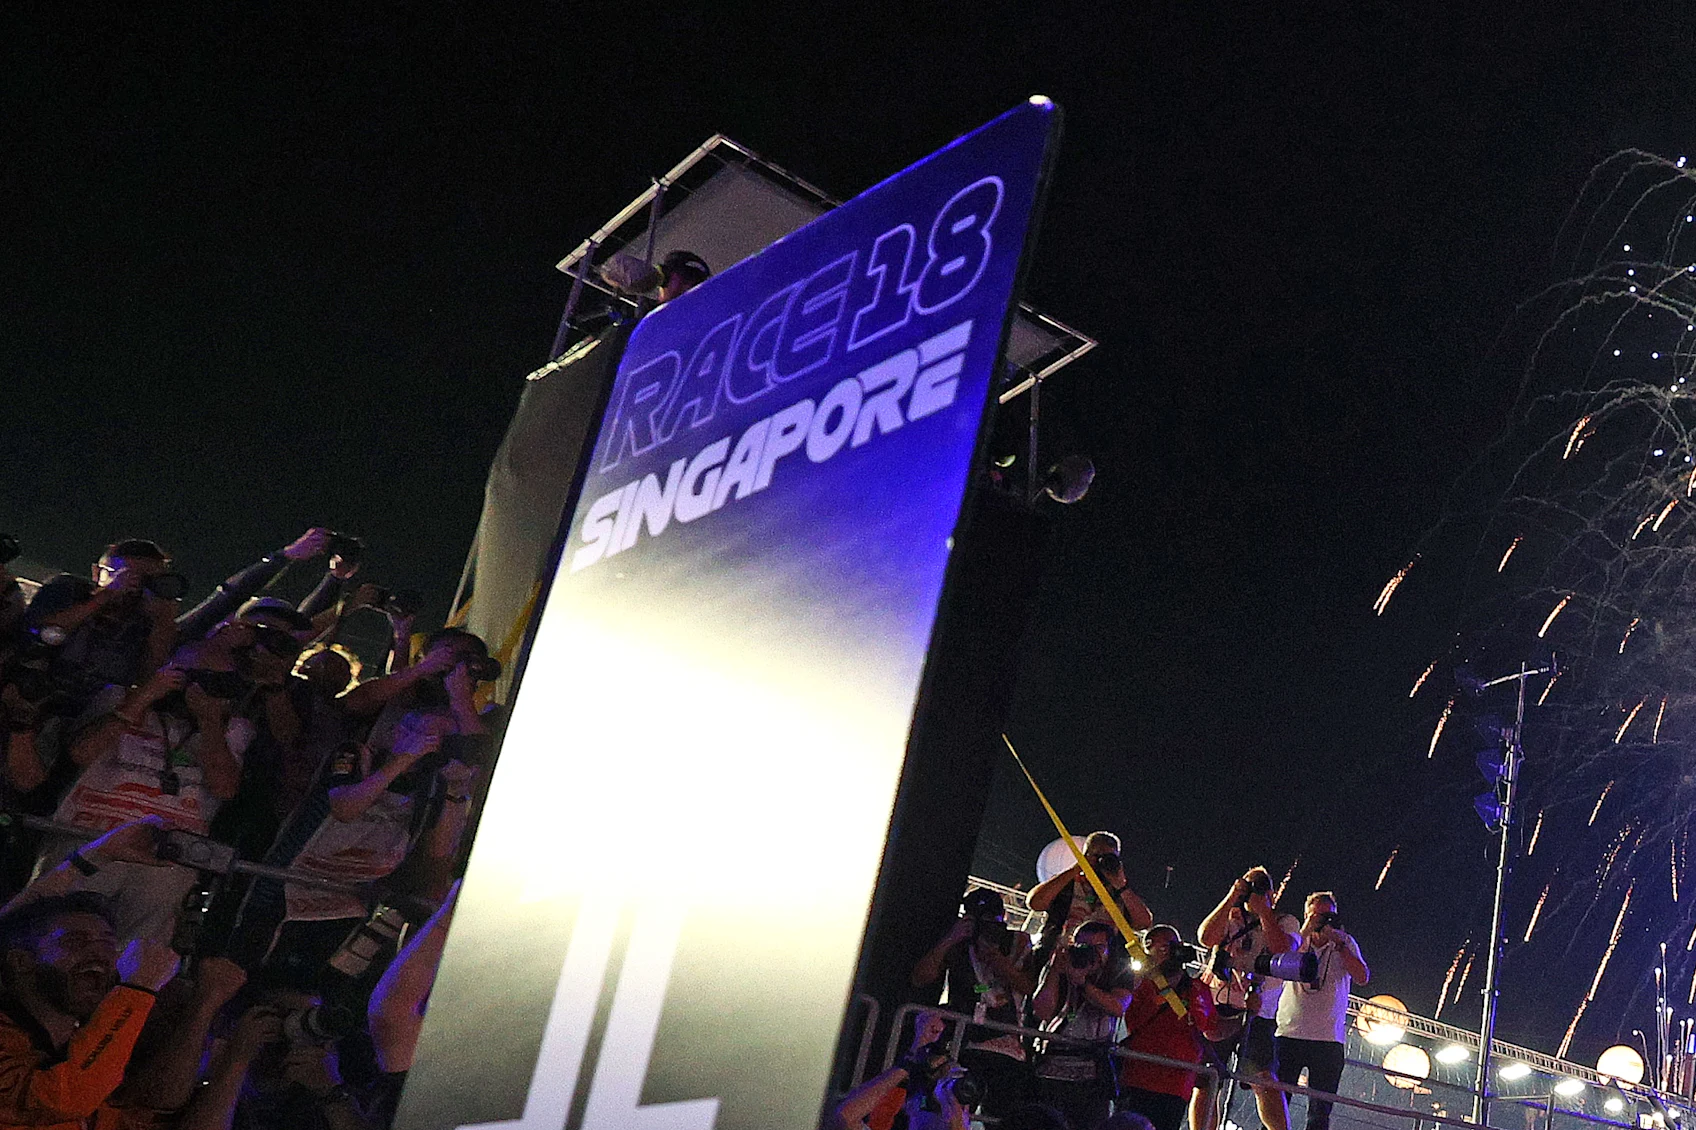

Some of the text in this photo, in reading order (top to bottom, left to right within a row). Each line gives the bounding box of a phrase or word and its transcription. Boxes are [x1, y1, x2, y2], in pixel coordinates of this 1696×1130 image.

[570, 320, 974, 575] SINGAPORE
[602, 175, 1005, 472] RACE 18
